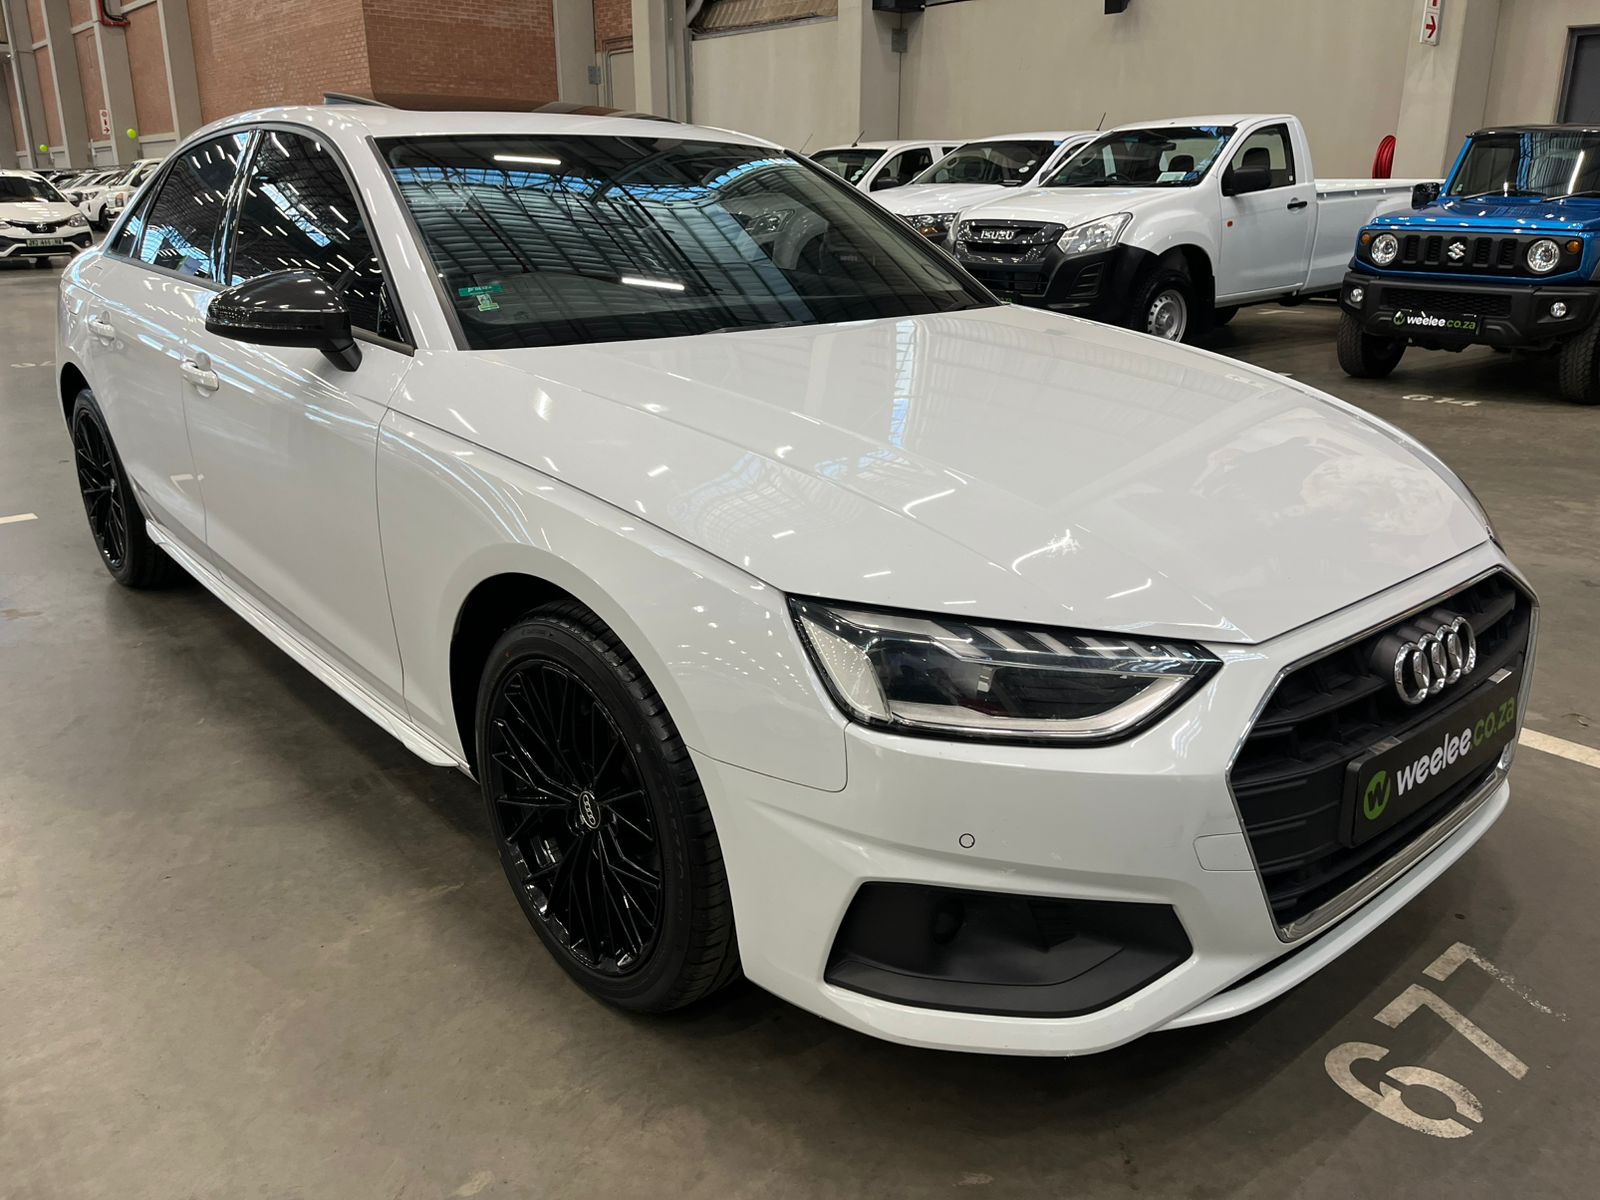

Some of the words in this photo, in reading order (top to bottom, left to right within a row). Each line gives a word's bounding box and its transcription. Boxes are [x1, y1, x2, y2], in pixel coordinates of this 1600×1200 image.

[981, 230, 1014, 240] ISUZU
[1407, 315, 1476, 330] weelee.co.za
[1397, 696, 1515, 796] weelee.co.za
